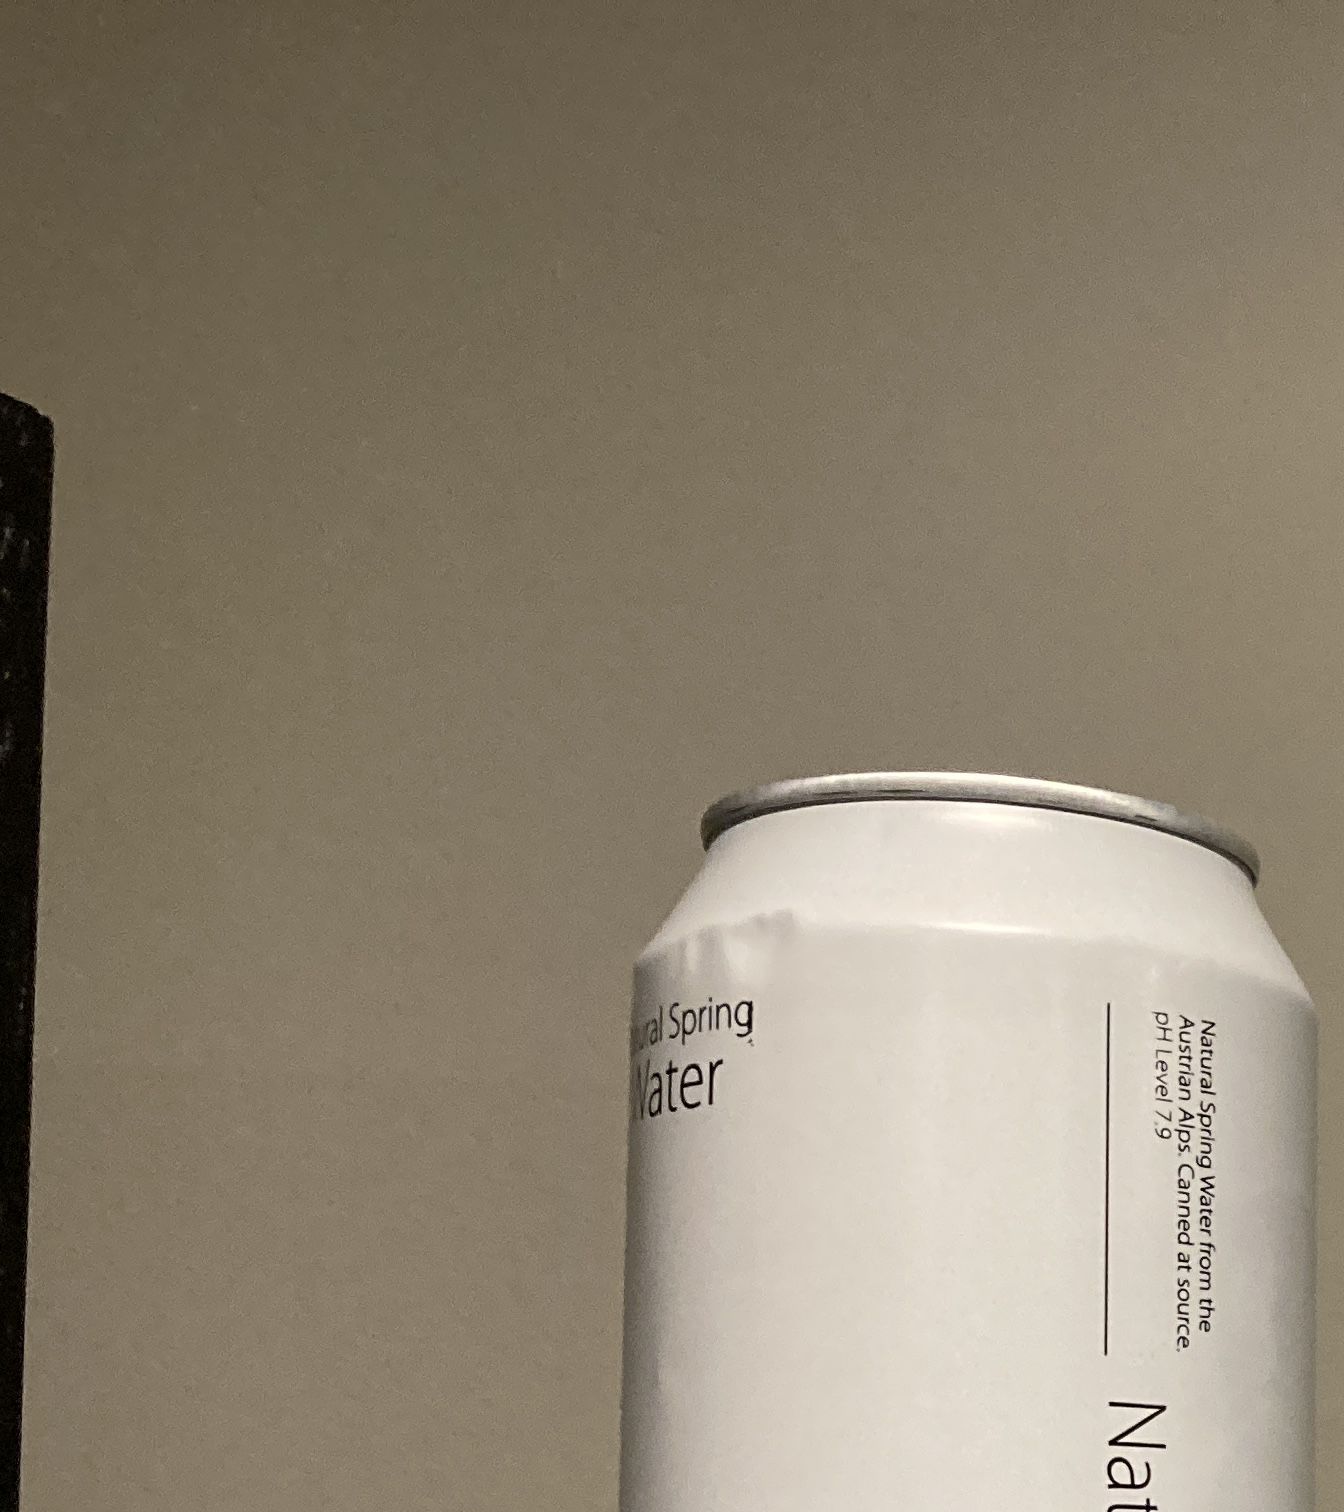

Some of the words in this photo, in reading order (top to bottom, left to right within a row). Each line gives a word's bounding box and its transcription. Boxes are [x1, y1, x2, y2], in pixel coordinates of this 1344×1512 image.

[669, 997, 753, 1045] Spring
[1152, 1010, 1173, 1041] pH
[1154, 1049, 1173, 1102] Level
[1178, 1014, 1195, 1101] Austrian
[1199, 1019, 1216, 1095] Natural
[1154, 1110, 1172, 1140] 7.9
[1174, 1108, 1195, 1157] Alps.
[1195, 1100, 1216, 1168] Spring
[1176, 1164, 1195, 1245] Canned
[1199, 1175, 1216, 1237] Water
[1176, 1252, 1194, 1272] at
[1199, 1240, 1216, 1290] from
[1176, 1278, 1194, 1352] source.
[1199, 1298, 1216, 1332] the
